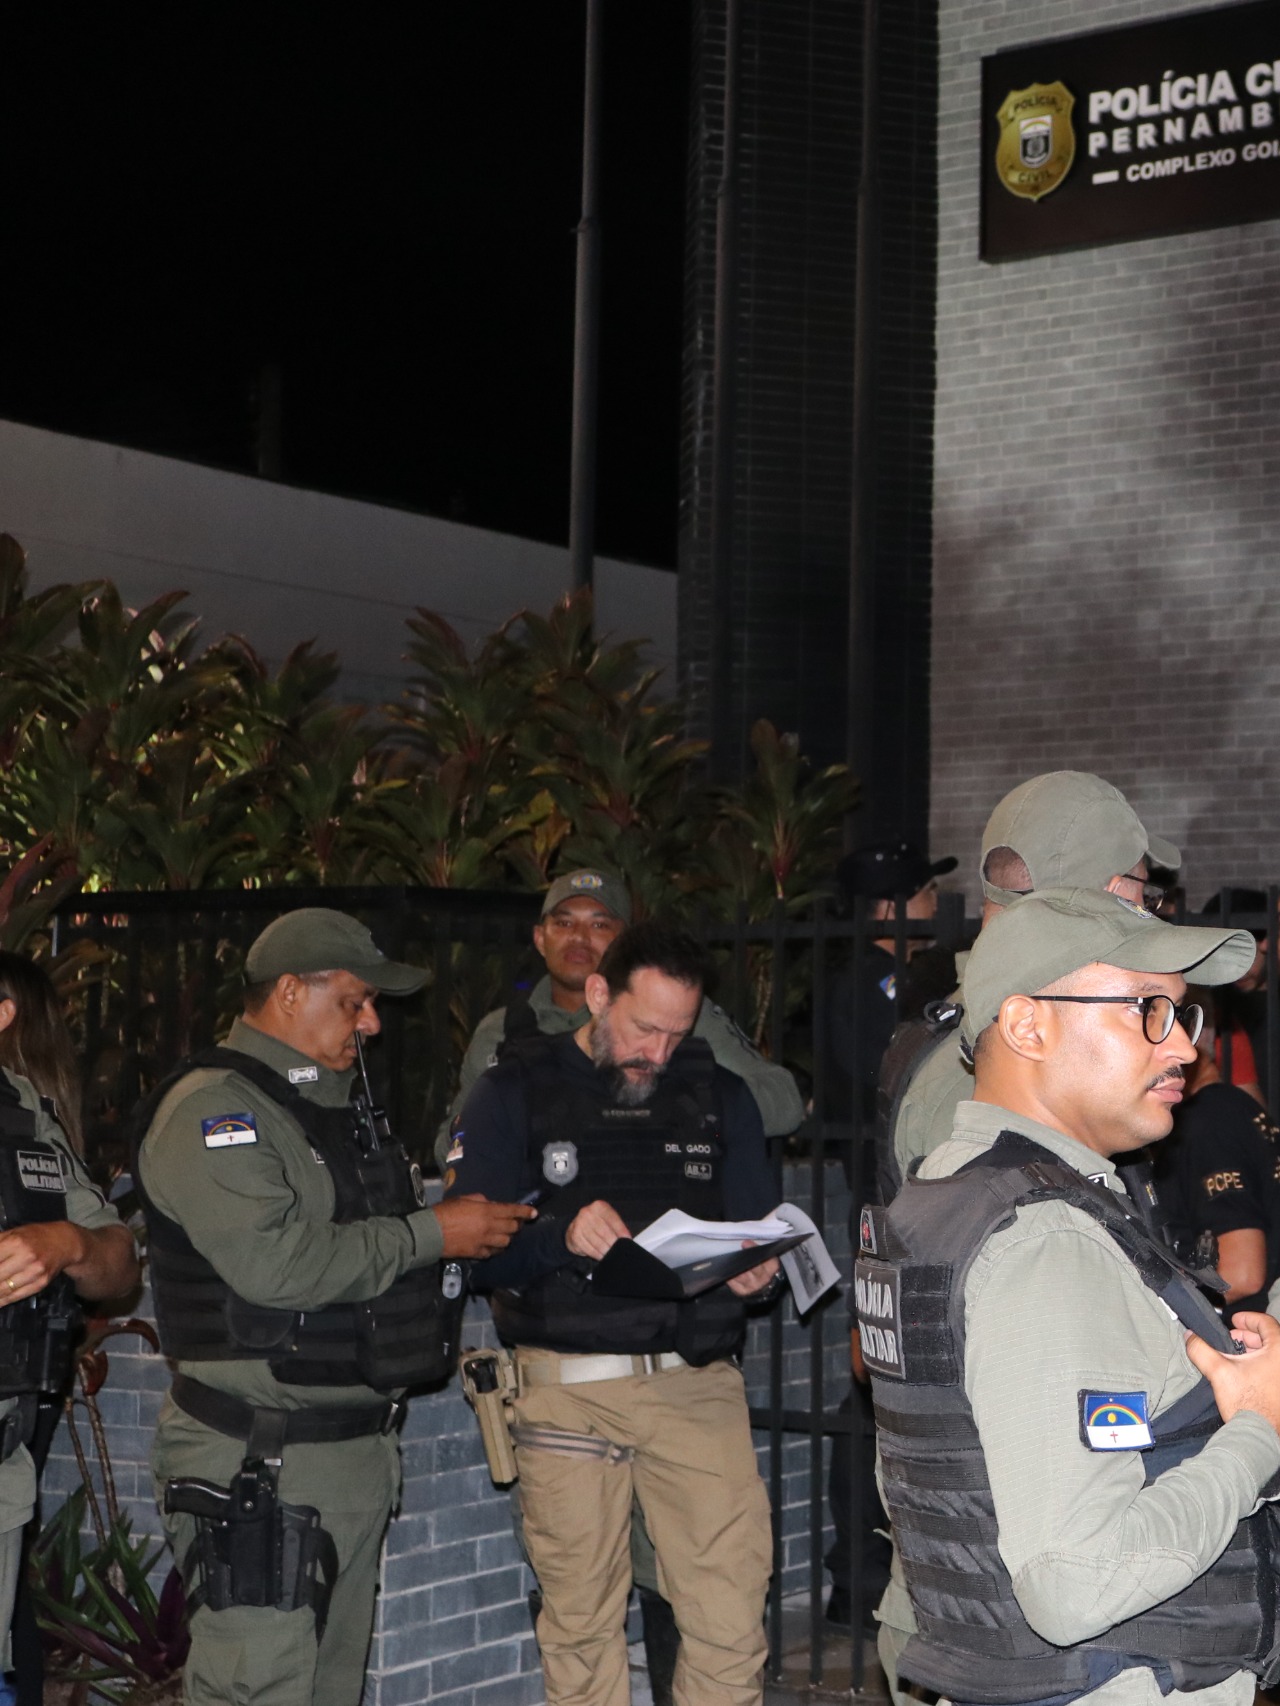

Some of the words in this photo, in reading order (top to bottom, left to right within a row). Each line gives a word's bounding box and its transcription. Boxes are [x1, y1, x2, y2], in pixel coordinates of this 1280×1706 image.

[1089, 70, 1237, 124] POLÍCIA
[1126, 148, 1237, 182] COMPLEXO
[686, 1145, 711, 1154] GADO
[1207, 1172, 1244, 1197] PCPE
